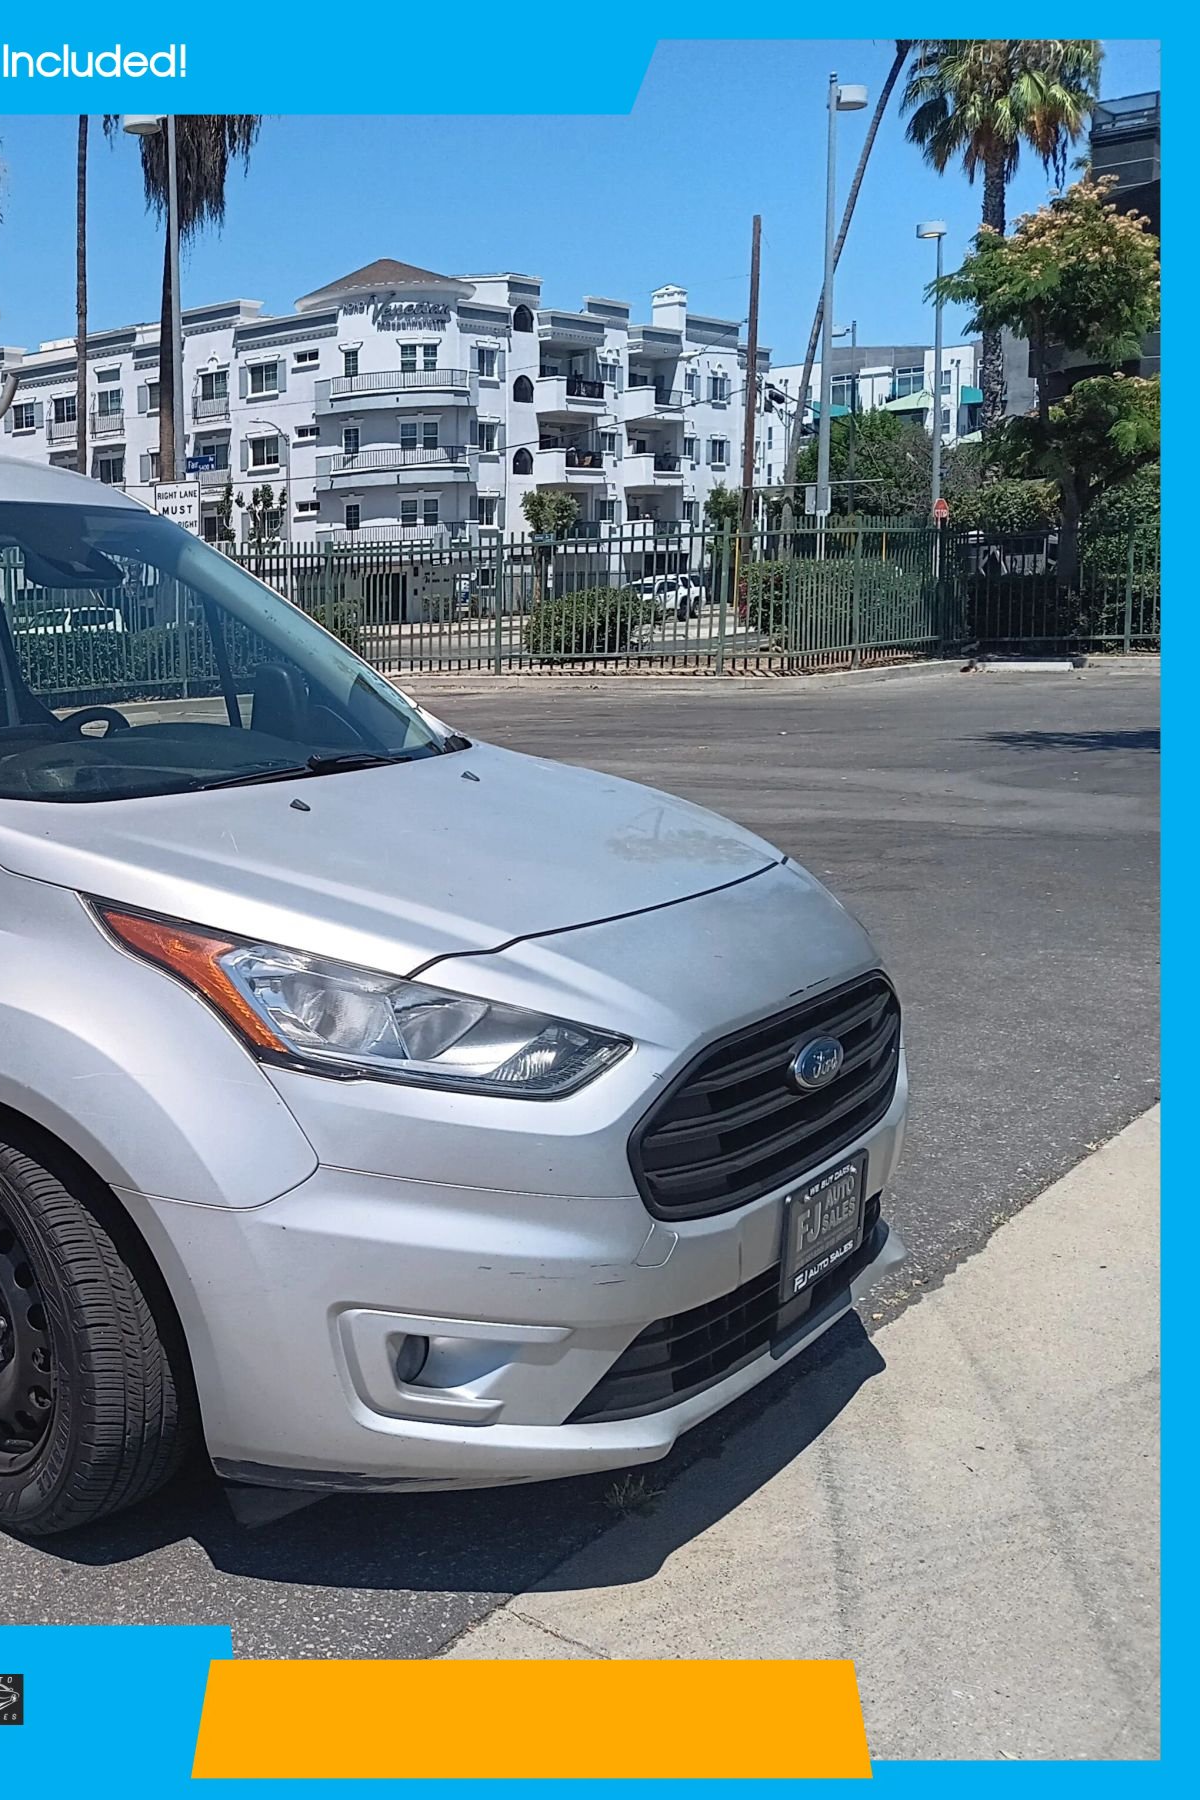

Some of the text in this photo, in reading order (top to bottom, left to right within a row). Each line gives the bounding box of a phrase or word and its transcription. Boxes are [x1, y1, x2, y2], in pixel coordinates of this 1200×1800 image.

[188, 460, 199, 469] Fair
[157, 489, 197, 500] RIGHT LANE
[162, 504, 193, 515] MUST
[934, 509, 948, 517] STOP
[809, 1164, 851, 1196] WE BUY CARS
[824, 1175, 855, 1211] AUTO
[796, 1201, 822, 1252] FJ
[821, 1196, 856, 1234] SALES
[793, 1269, 809, 1293] FJ
[808, 1260, 829, 1280] AUTO
[829, 1239, 854, 1264] SALES
